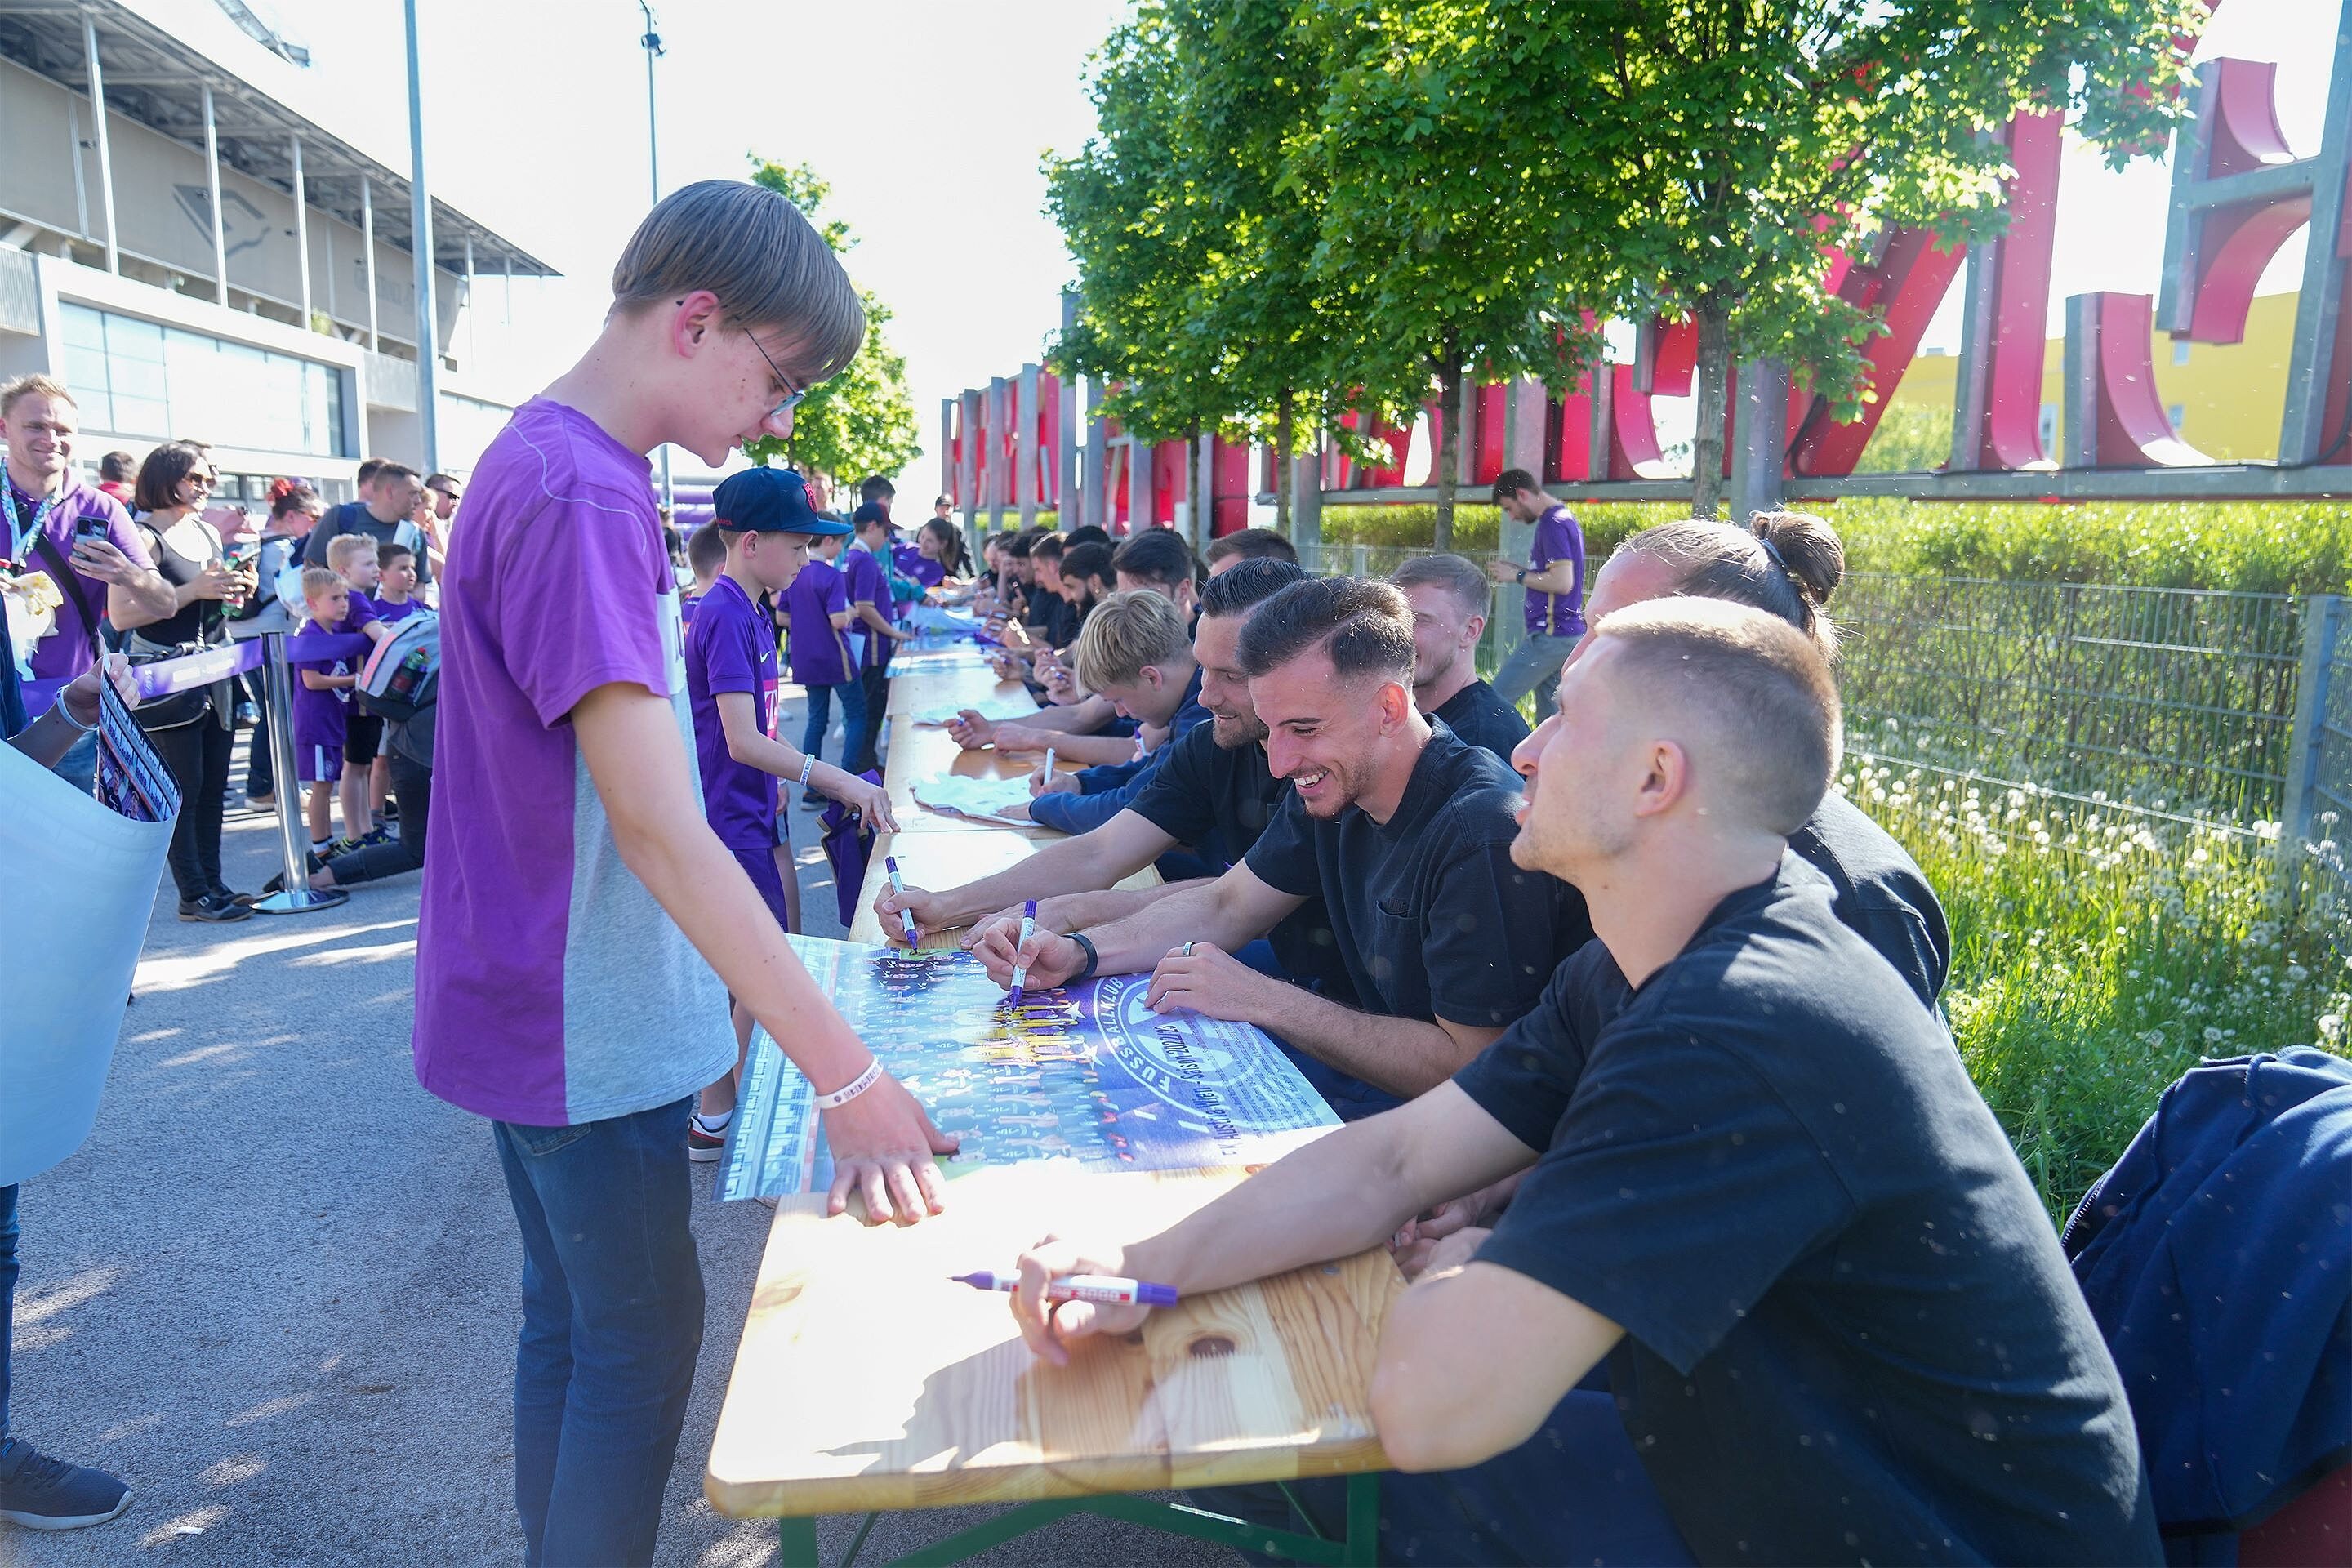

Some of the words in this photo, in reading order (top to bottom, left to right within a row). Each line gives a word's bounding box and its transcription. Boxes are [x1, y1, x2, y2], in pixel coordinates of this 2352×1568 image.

[1100, 977, 1171, 1094] FUSSBALLKLUB
[1154, 1025, 1190, 1054] 2022/23
[1175, 1055, 1205, 1080] Saison
[1193, 1087, 1221, 1109] Wien
[1205, 1109, 1241, 1139] Austria
